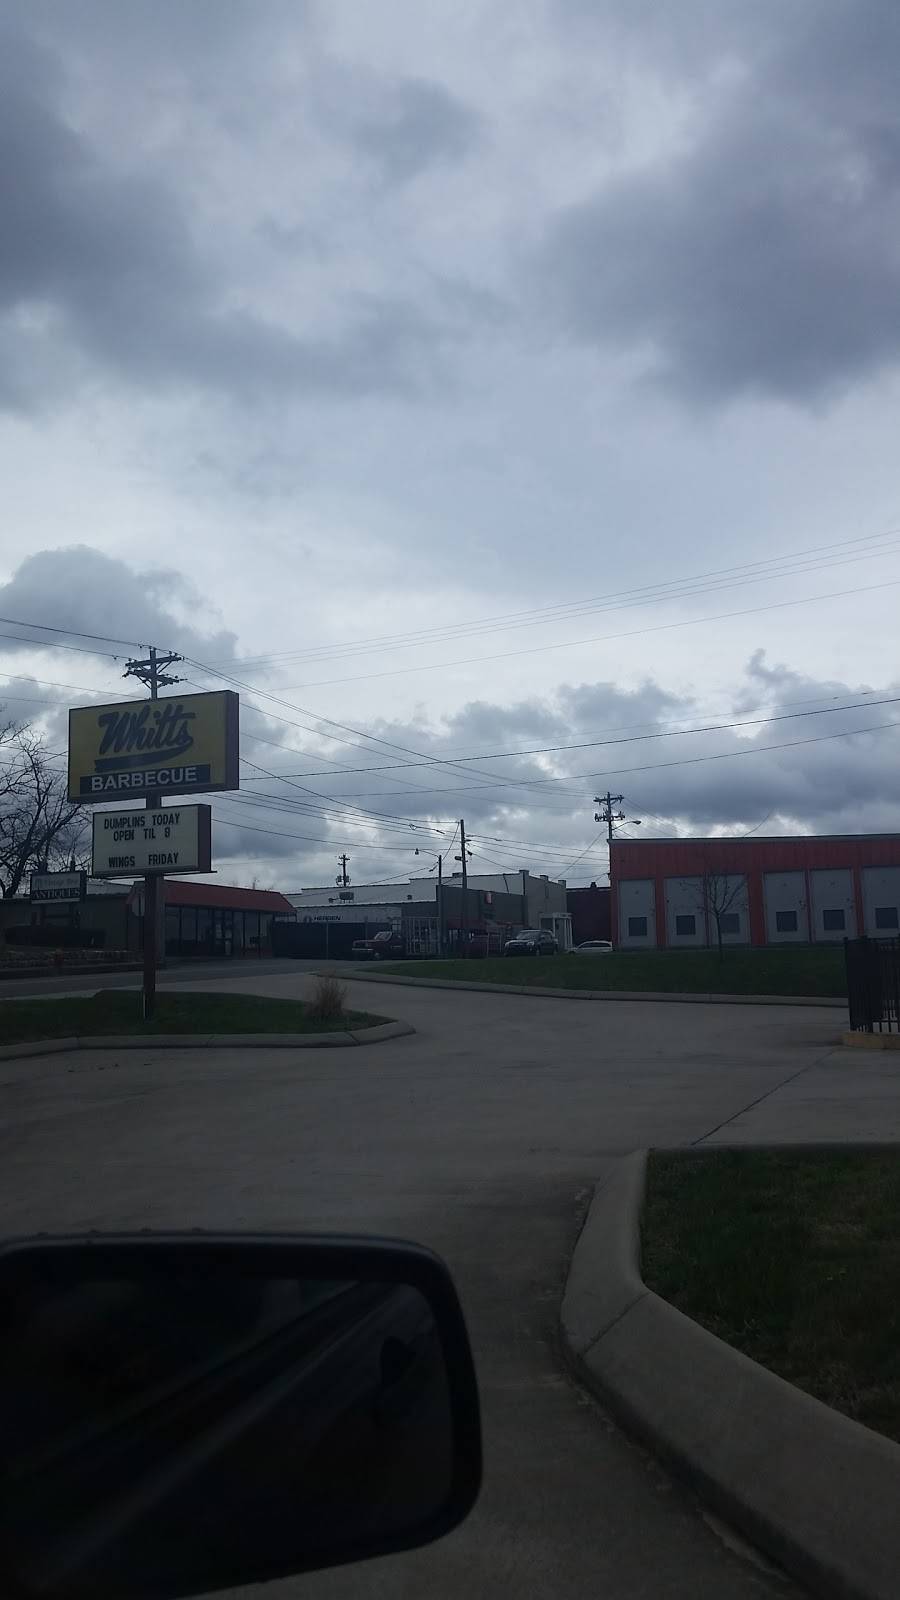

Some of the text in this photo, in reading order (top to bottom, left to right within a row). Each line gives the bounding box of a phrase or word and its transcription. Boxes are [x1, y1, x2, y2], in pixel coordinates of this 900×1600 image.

[91, 767, 197, 792] BARBECUE
[104, 813, 181, 830] DUMPLINS TODAY
[113, 830, 135, 842] OPEN
[144, 828, 156, 840] TIL
[108, 853, 179, 868] WINGS FRIDAY
